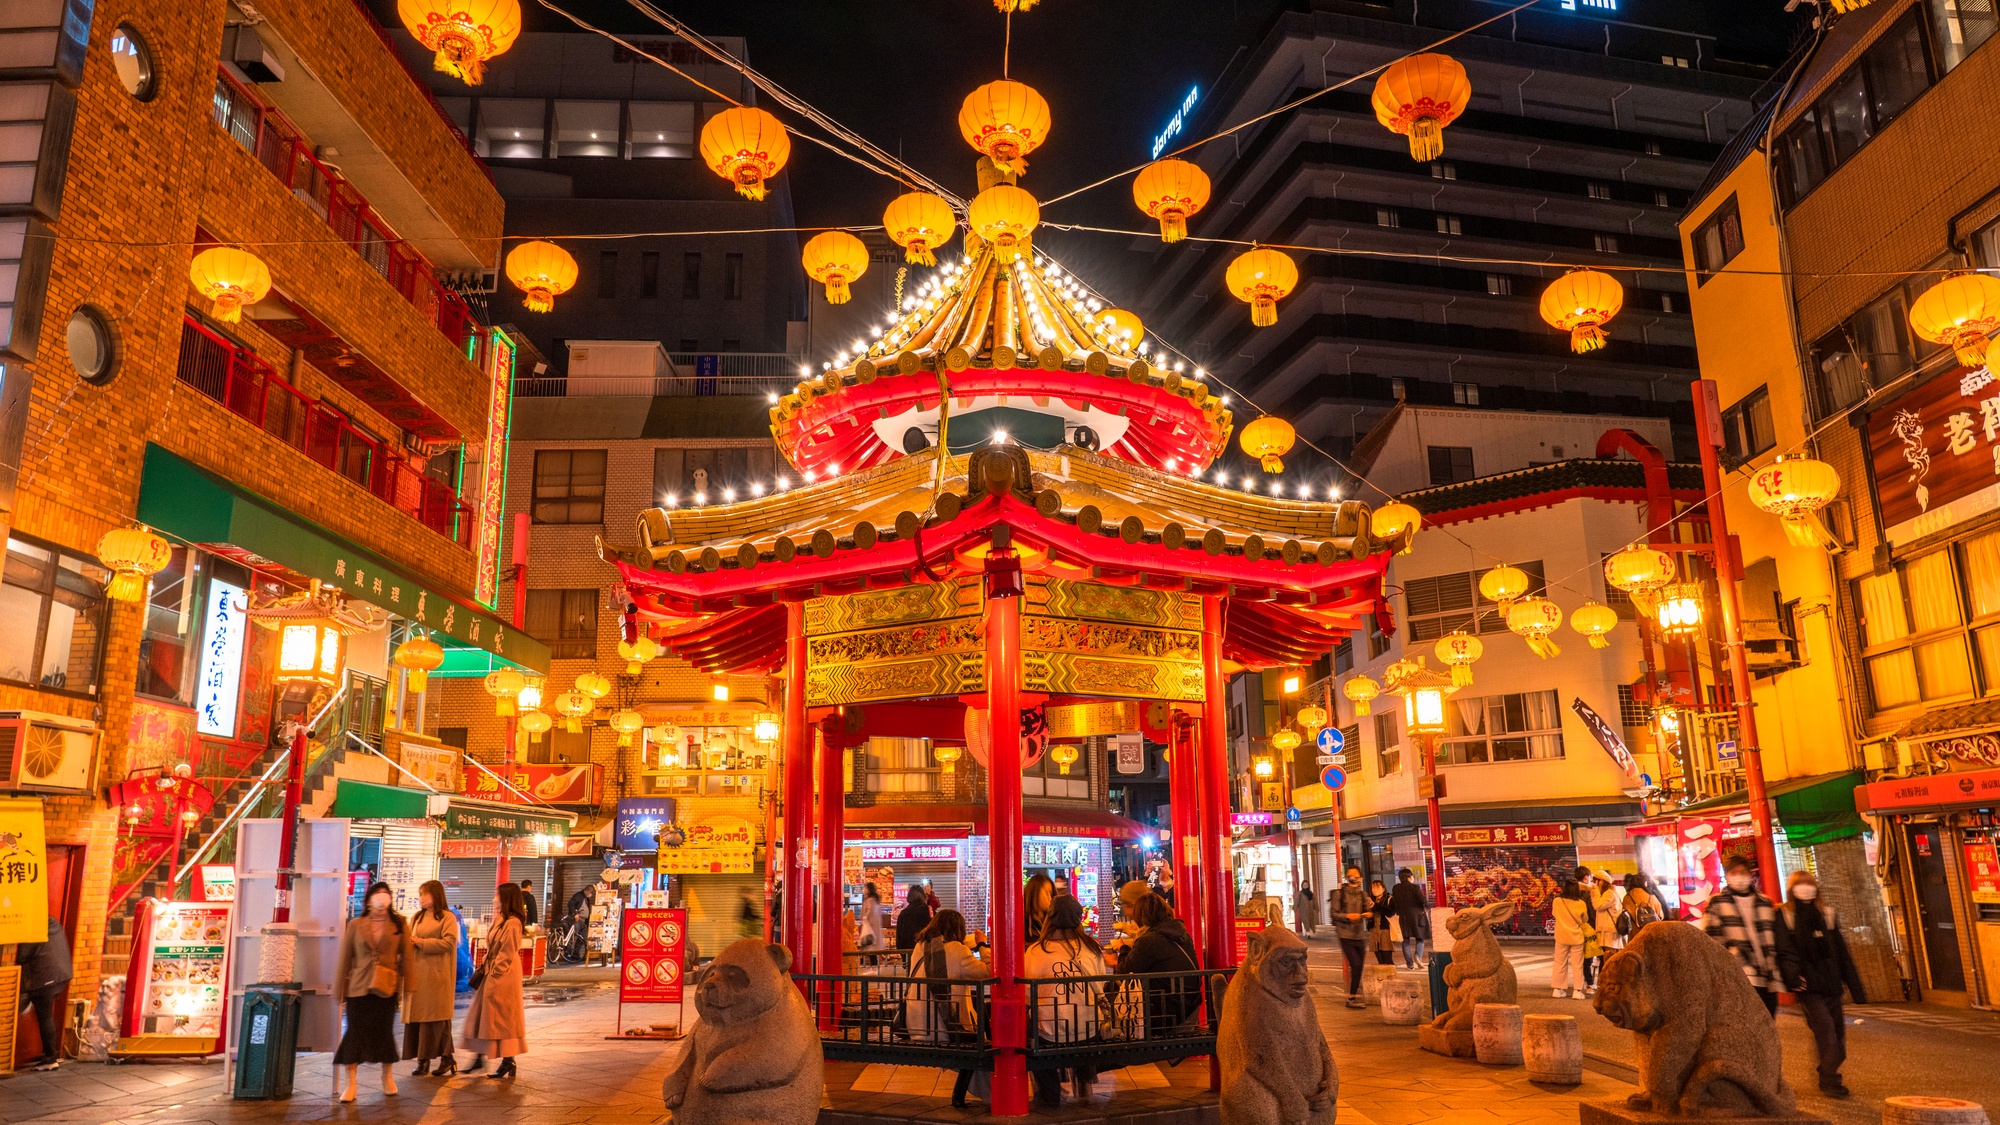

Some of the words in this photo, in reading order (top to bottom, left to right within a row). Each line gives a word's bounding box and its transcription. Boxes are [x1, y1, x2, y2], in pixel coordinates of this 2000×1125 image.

[1153, 109, 1182, 160] dormy
[1183, 86, 1197, 117] inn
[335, 559, 400, 603] 廣東料理
[415, 590, 505, 654] 東榮酒家
[676, 714, 698, 722] Cafe
[703, 712, 729, 723] 彩花
